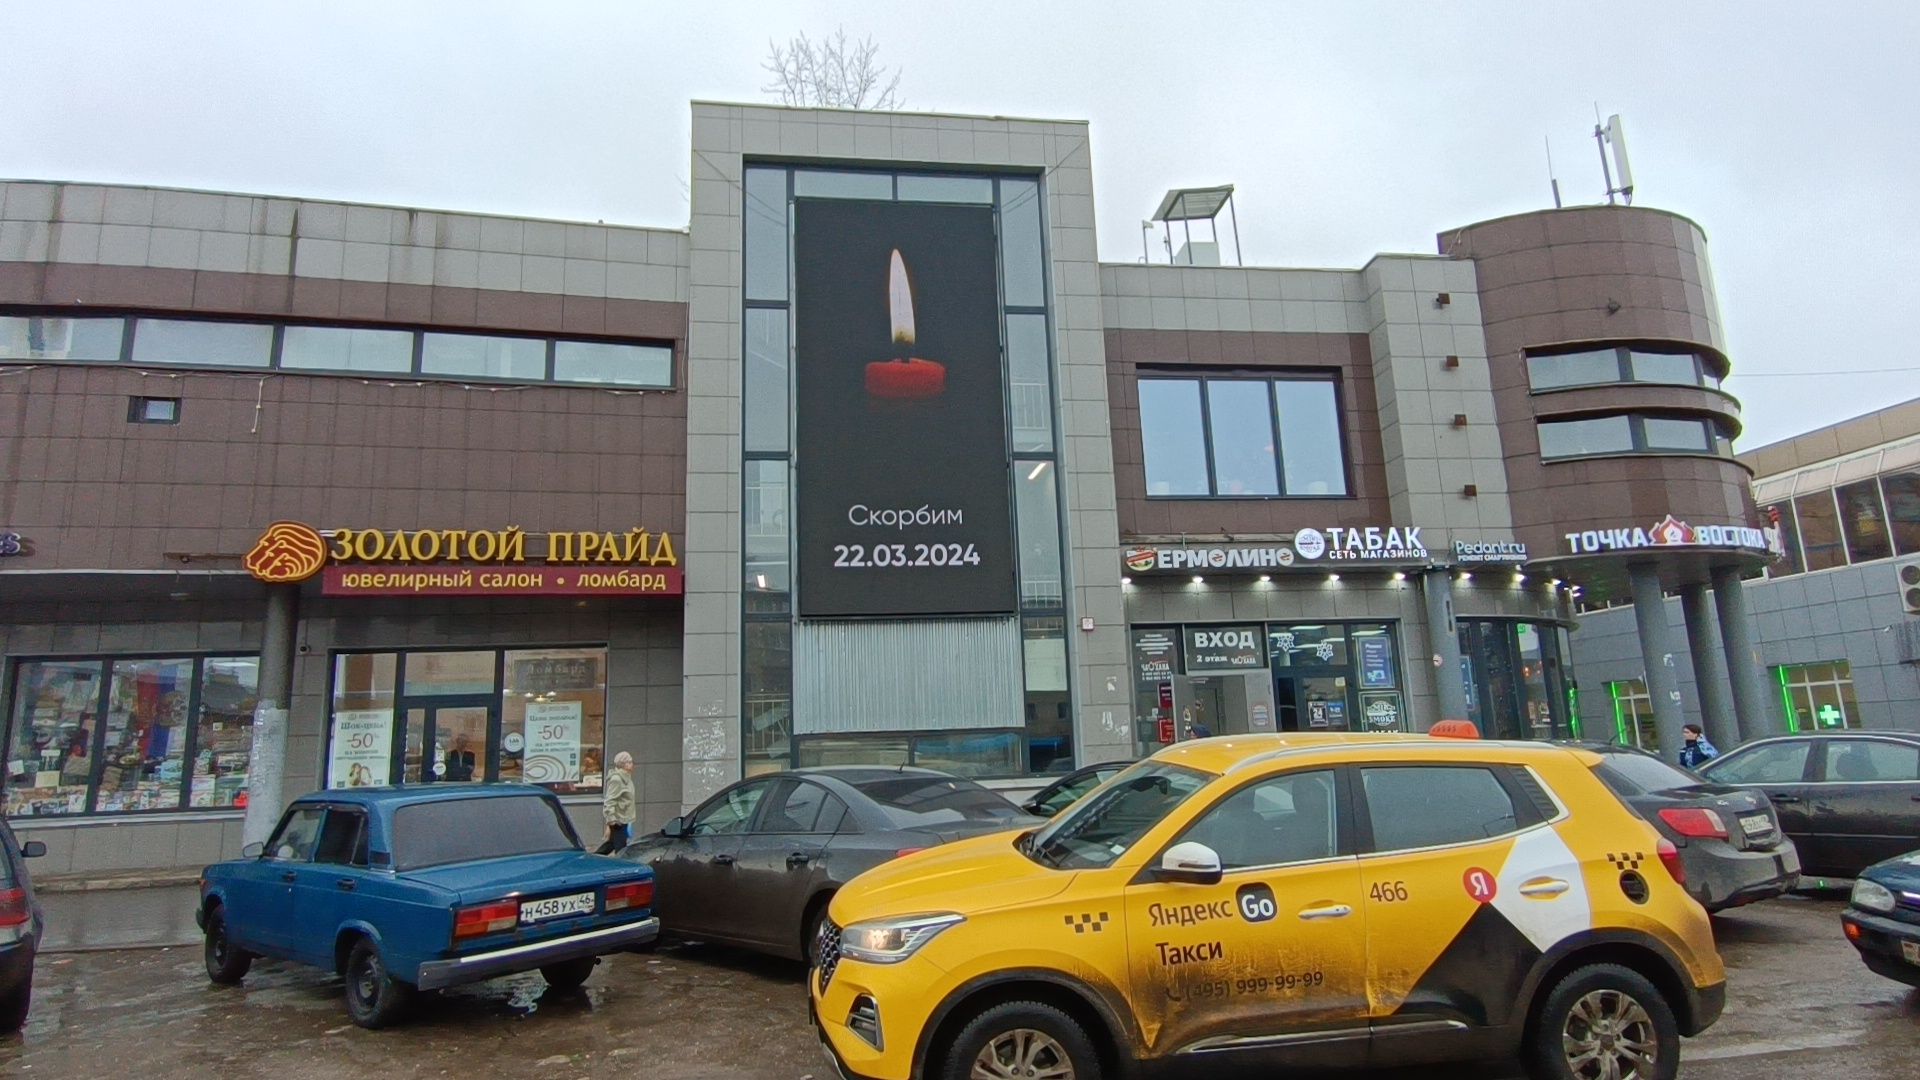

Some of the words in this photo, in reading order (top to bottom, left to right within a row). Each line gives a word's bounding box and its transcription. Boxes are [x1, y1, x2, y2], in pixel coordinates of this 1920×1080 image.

[849, 504, 963, 530] Скорбим
[331, 525, 526, 562] ЗОЛОТОЙ
[546, 526, 677, 566] ПРАЙД
[1326, 527, 1424, 551] ТАБАК
[1565, 527, 1649, 553] ТОЧКА
[834, 543, 981, 567] 22.03.2024
[1158, 548, 1295, 569] ЕРМОЛИНО
[1329, 550, 1357, 560] СЕТЬ
[1360, 549, 1428, 559] МАГАЗИНОВ
[342, 570, 472, 591] ювелирный
[479, 572, 543, 588] салон
[577, 571, 667, 590] ломбард
[1194, 631, 1256, 649] ВХОД
[1196, 655, 1203, 663] 2
[1369, 880, 1408, 902] 466
[1470, 871, 1490, 896] Я
[1149, 900, 1234, 927] Яндекс
[1241, 894, 1274, 918] Go
[1155, 941, 1223, 966] Такси
[1235, 971, 1323, 994] 999-99-99
